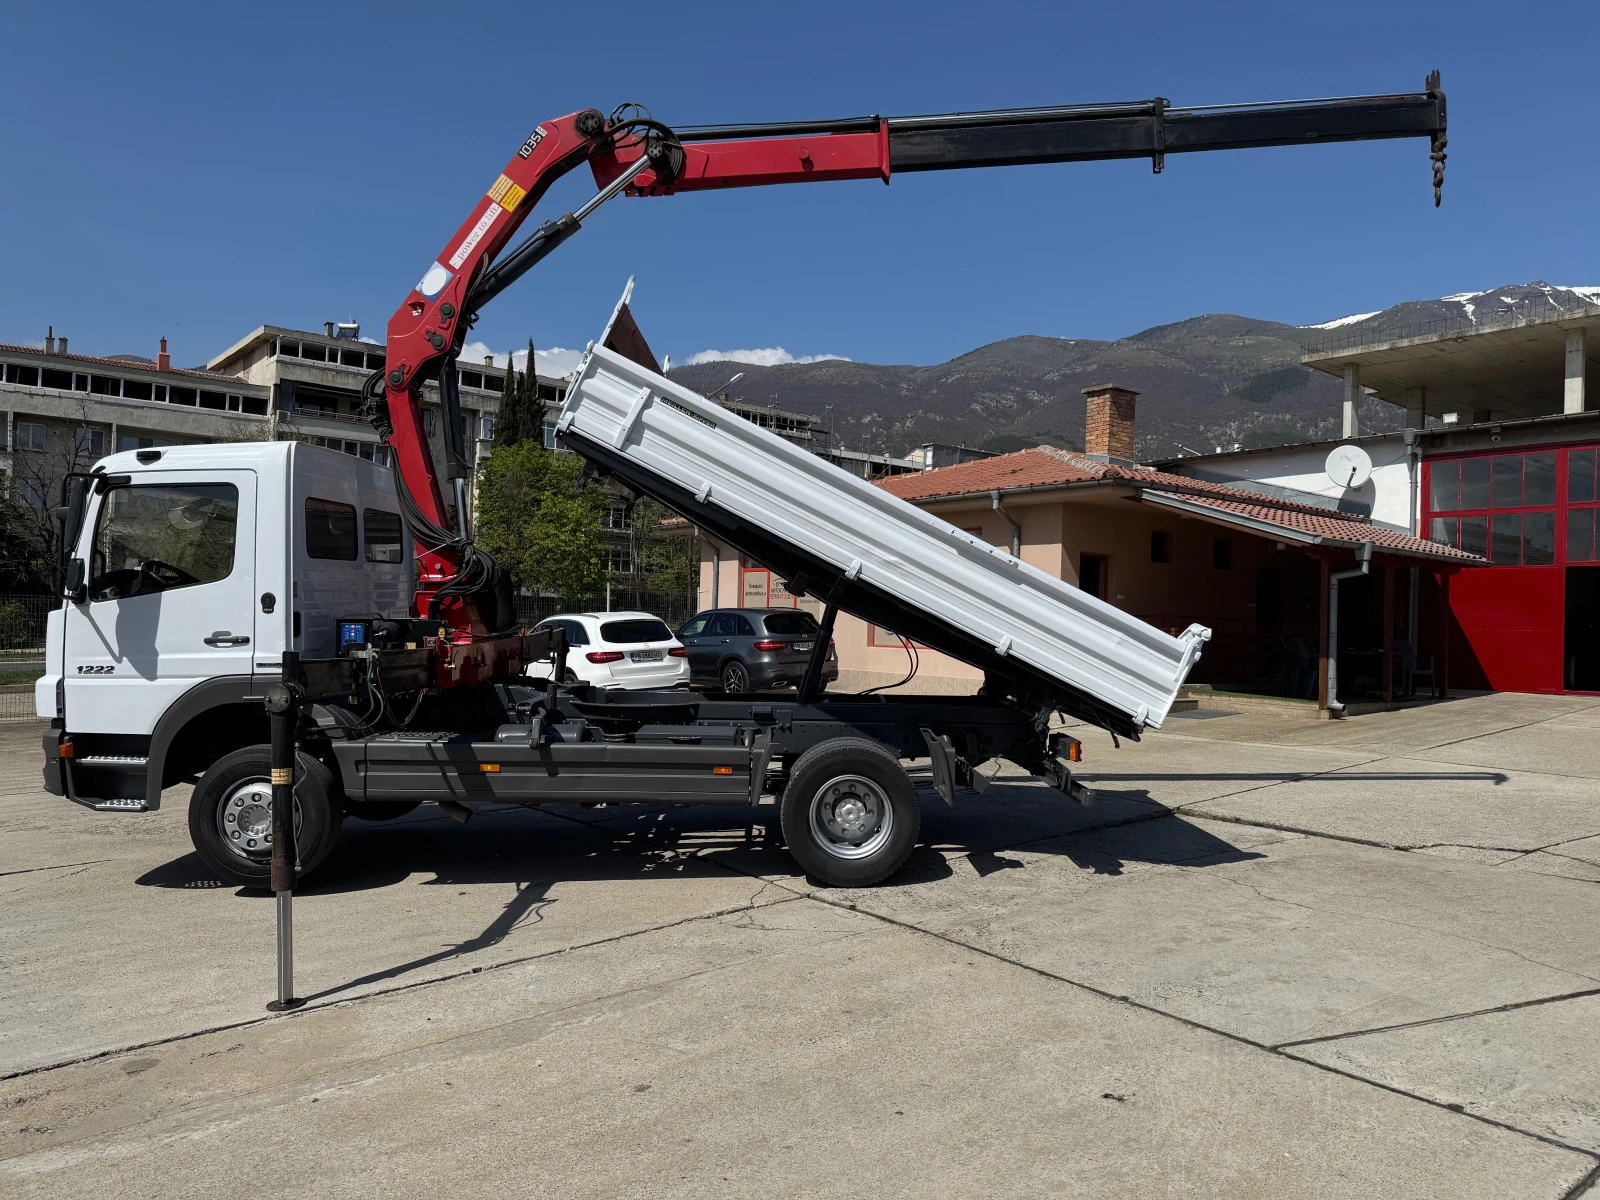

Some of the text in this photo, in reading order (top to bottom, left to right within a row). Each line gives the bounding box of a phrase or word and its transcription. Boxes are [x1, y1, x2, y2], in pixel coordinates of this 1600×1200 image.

[519, 132, 542, 158] 1035
[458, 233, 478, 261] power
[477, 220, 488, 234] to
[76, 665, 115, 675] 1222
